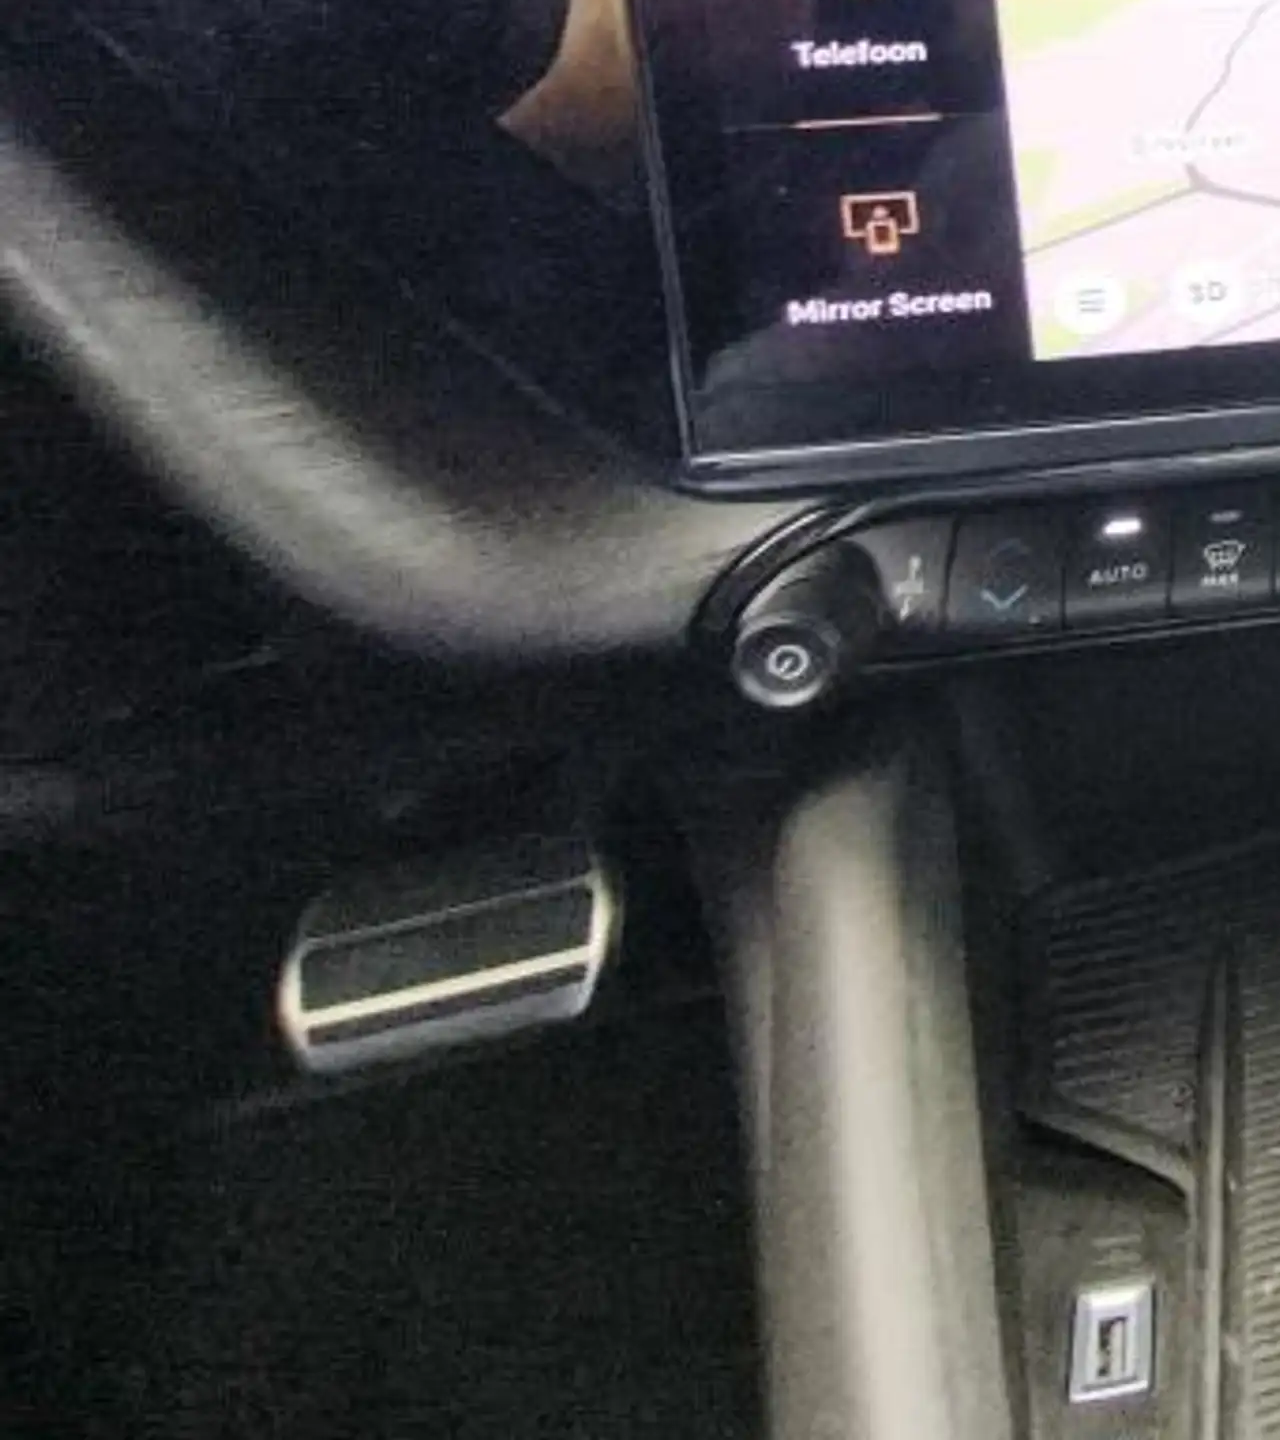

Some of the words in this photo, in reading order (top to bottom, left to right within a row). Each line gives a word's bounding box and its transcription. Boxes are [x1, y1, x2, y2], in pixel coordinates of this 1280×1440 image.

[790, 38, 928, 68] Telefoon
[787, 298, 883, 325] Mirror
[887, 290, 993, 318] Screen
[1088, 561, 1149, 586] AUTO
